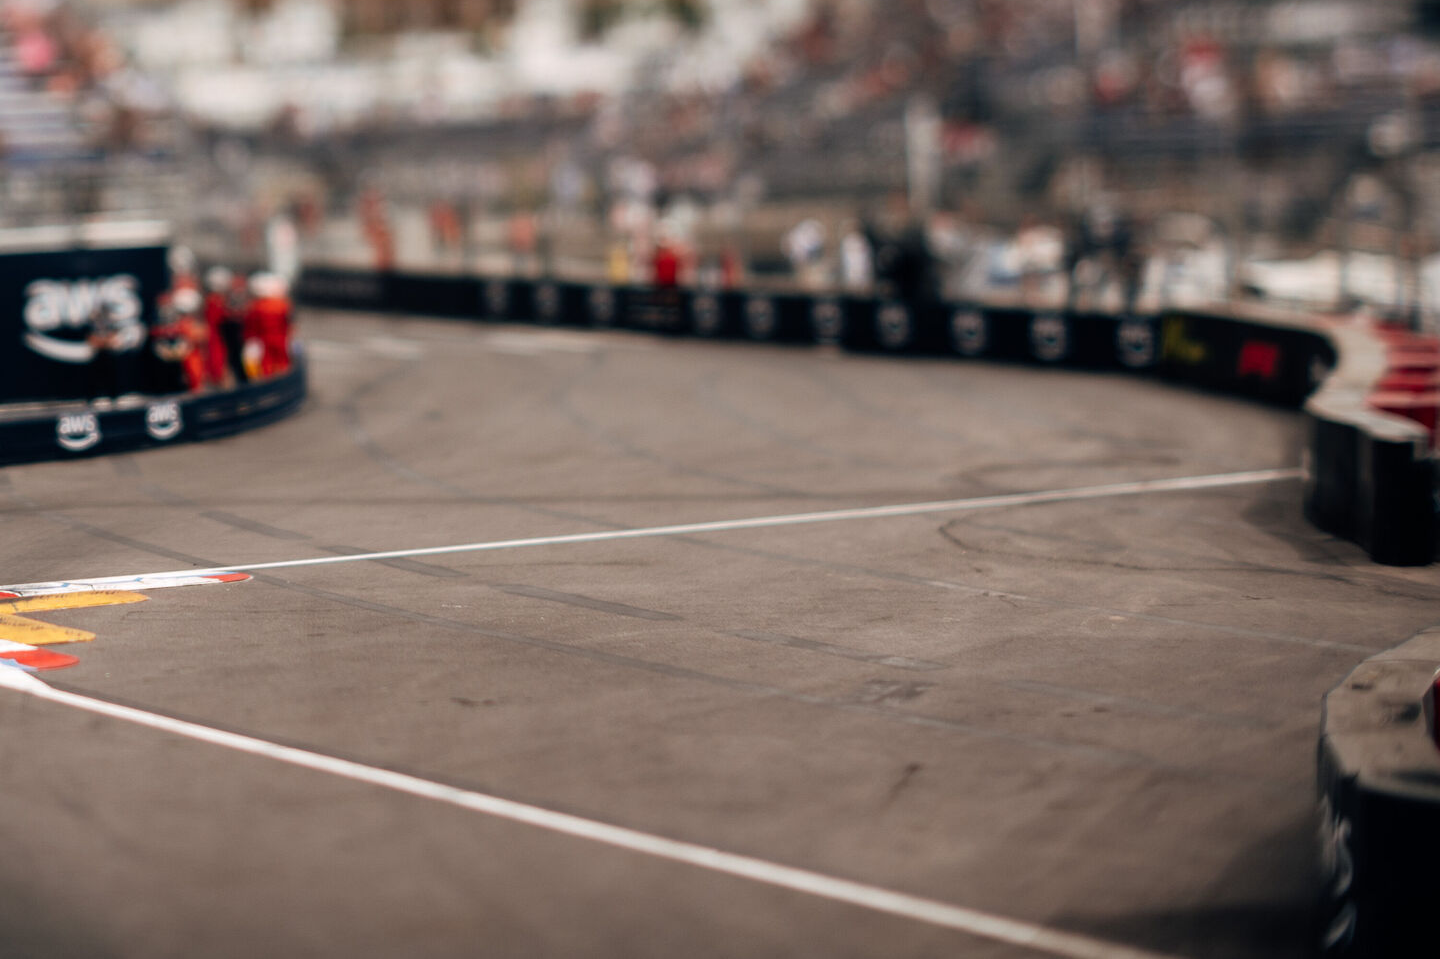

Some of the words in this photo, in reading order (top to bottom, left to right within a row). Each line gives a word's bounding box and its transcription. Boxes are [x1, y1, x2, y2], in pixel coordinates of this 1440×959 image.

[23, 273, 141, 331] aws
[58, 412, 98, 434] aws
[146, 401, 179, 423] aws
